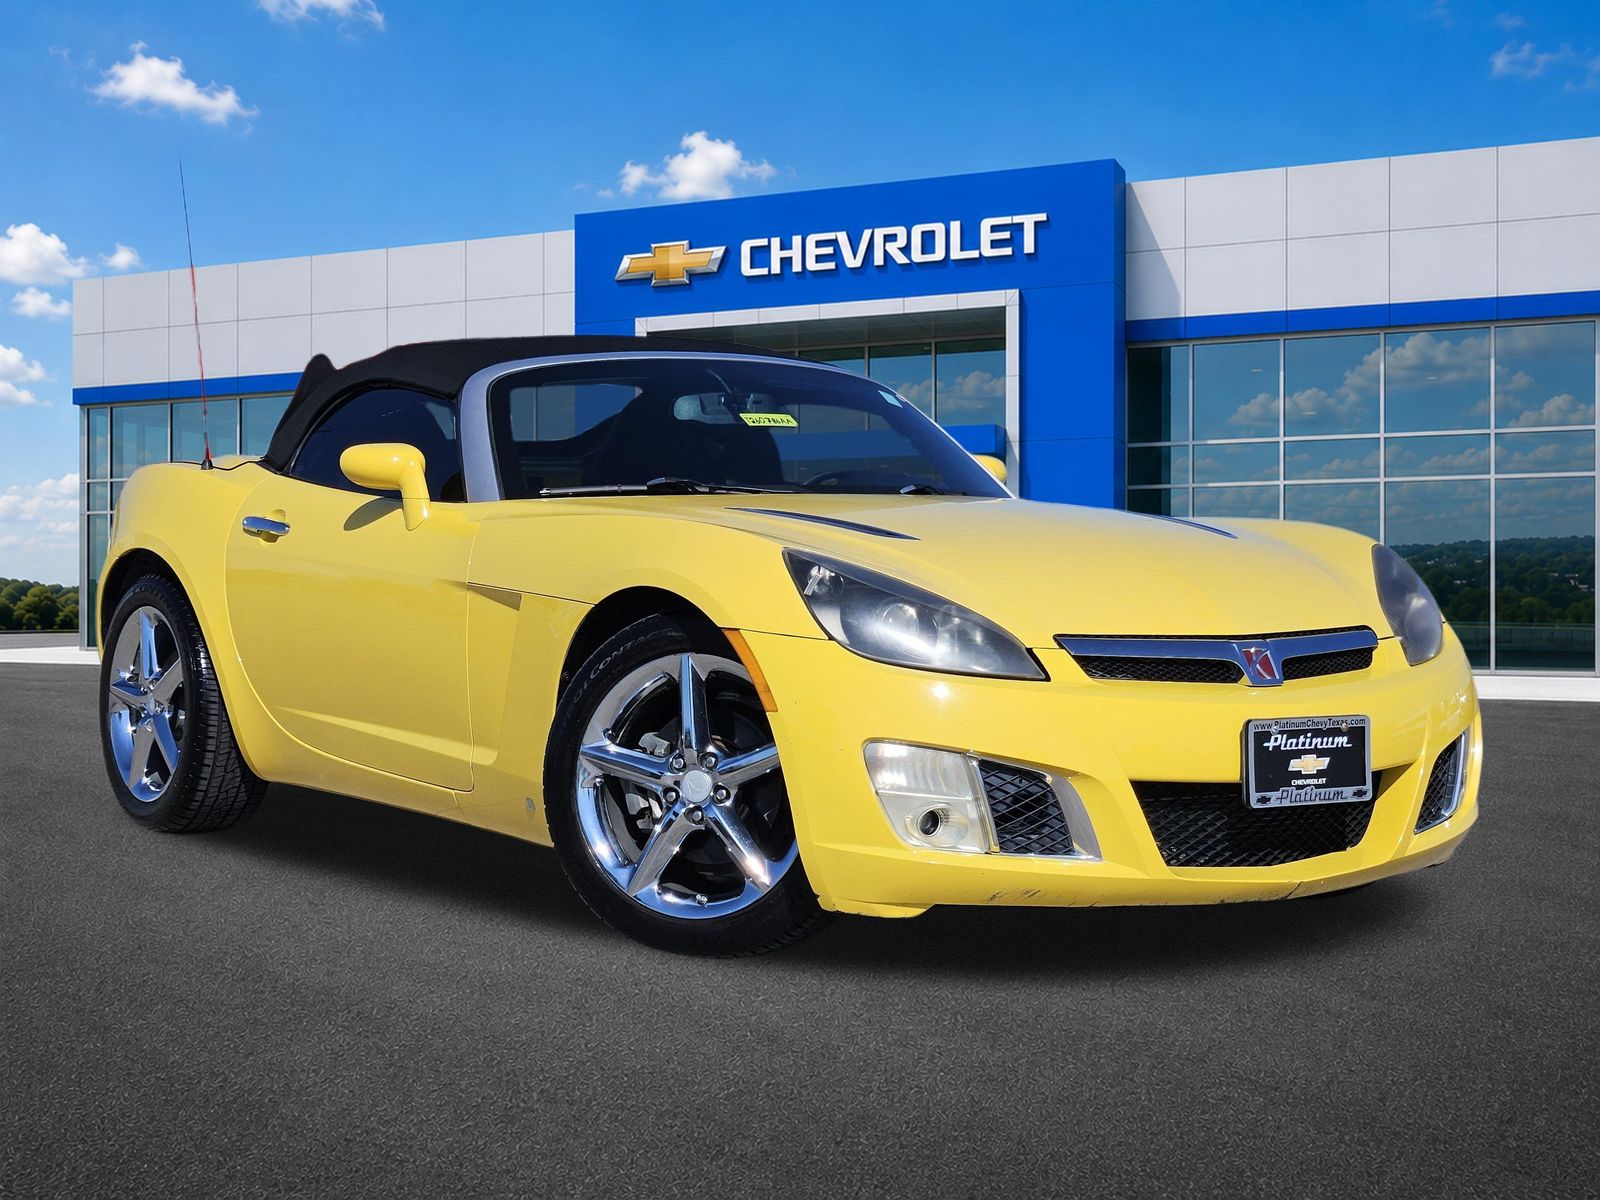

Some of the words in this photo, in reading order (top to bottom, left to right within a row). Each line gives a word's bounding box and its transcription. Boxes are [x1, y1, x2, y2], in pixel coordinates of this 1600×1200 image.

[740, 213, 1047, 277] CHEVROLET
[1254, 718, 1365, 730] wwwPlatinumChevyTexas.com
[1263, 733, 1352, 751] Platinum
[1291, 777, 1327, 786] CHEVROLET
[1276, 787, 1349, 804] Platinum
